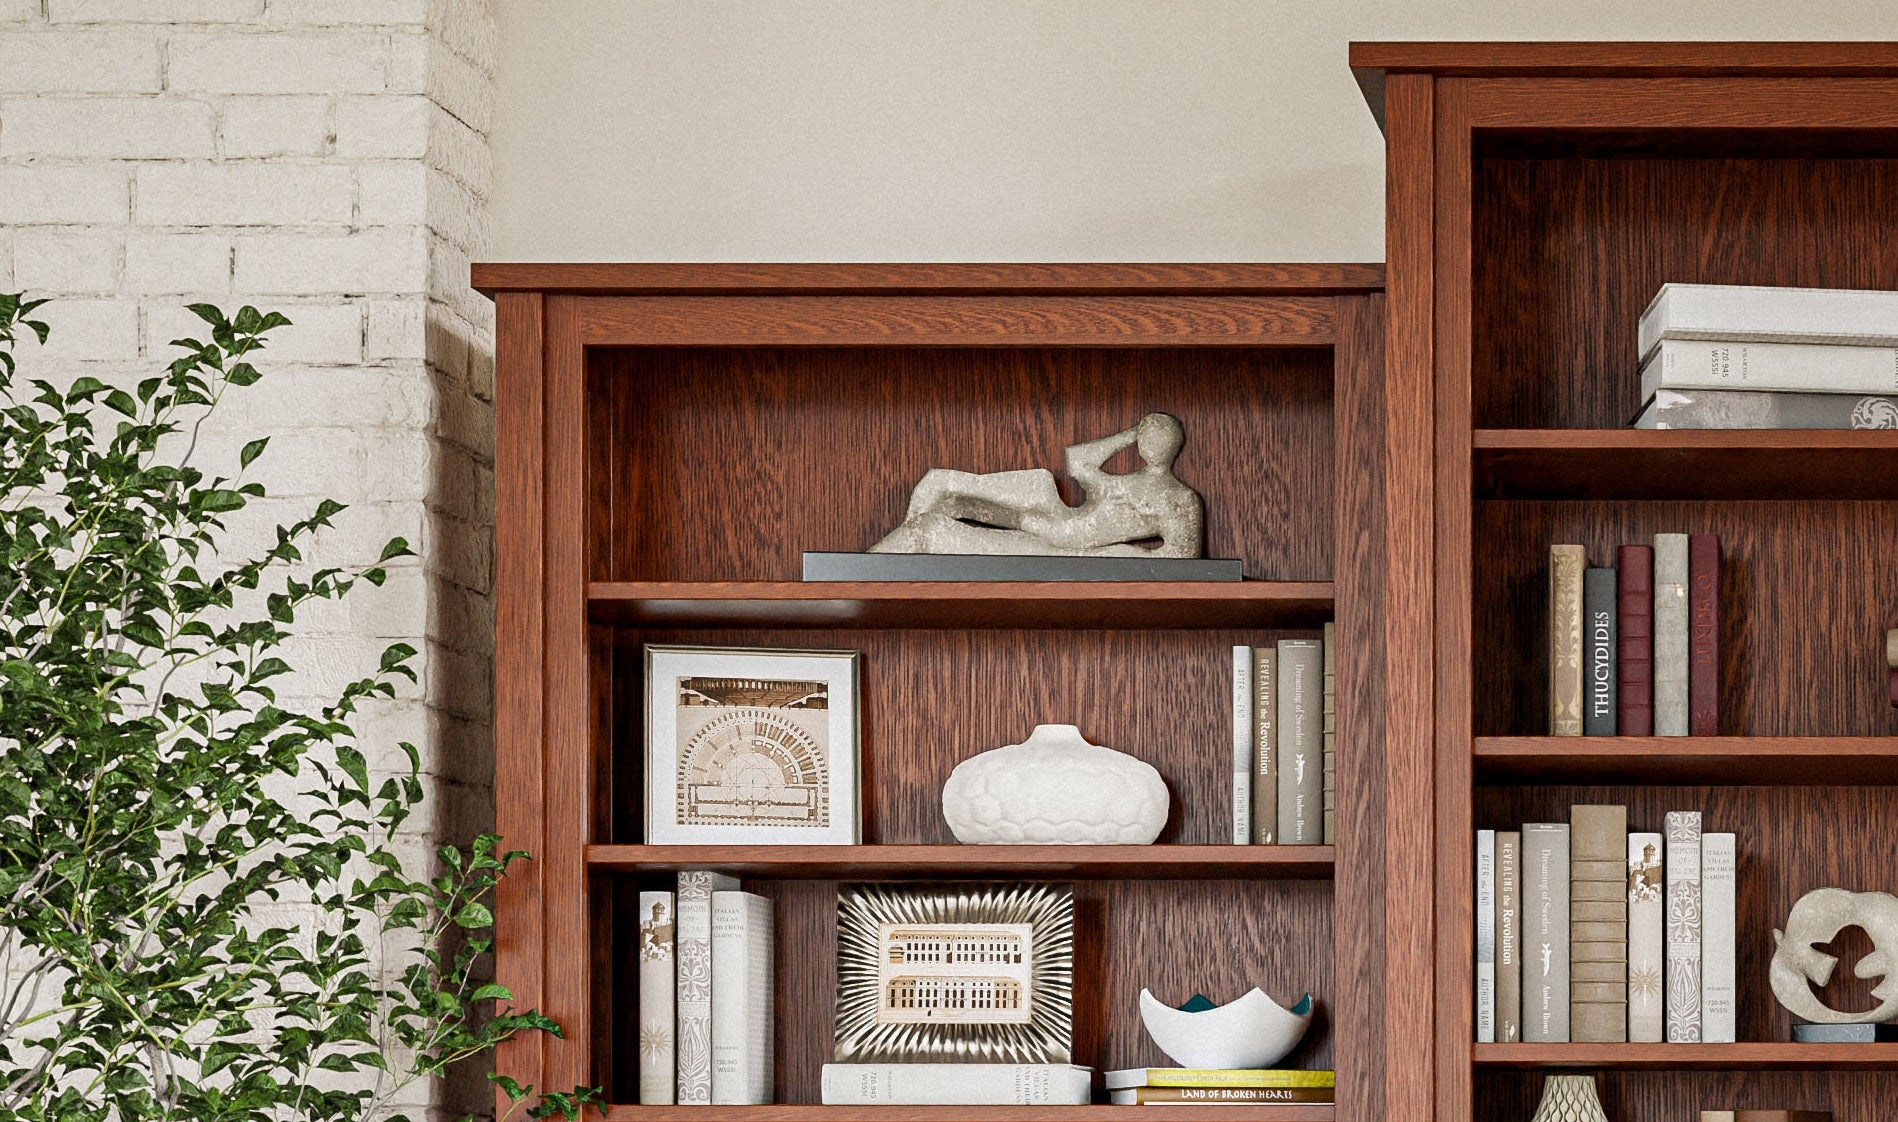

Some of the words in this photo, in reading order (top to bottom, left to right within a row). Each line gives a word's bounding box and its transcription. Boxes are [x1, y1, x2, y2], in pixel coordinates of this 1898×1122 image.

[1594, 611, 1609, 718] THUCYDIDES
[1237, 668, 1245, 690] AFTER
[1260, 659, 1269, 706] REVEALING
[1293, 664, 1304, 704] Dreaming
[1237, 704, 1245, 719] END
[1295, 714, 1305, 746] Sweden
[1260, 722, 1271, 775] Revolution
[1237, 786, 1245, 813] AUTHOR
[1296, 793, 1304, 818] Andrew
[1237, 816, 1245, 837] NAME
[1296, 820, 1304, 841] Brown
[1481, 854, 1490, 876] AFTER
[1503, 843, 1513, 892] REVEALING
[1540, 849, 1551, 890] Dreaming
[1481, 891, 1490, 906] END
[1541, 900, 1551, 935] Sweden
[1503, 909, 1514, 965] Revolution
[1481, 978, 1490, 1006] AUTHOR
[1542, 985, 1551, 1011] Andrew
[1481, 1009, 1490, 1030] NAME
[1542, 1012, 1551, 1035] Brown
[1181, 1089, 1206, 1099] LAND
[1207, 1089, 1219, 1099] OF
[1221, 1089, 1257, 1099] BROKEN
[1259, 1090, 1293, 1100] HEARTS
